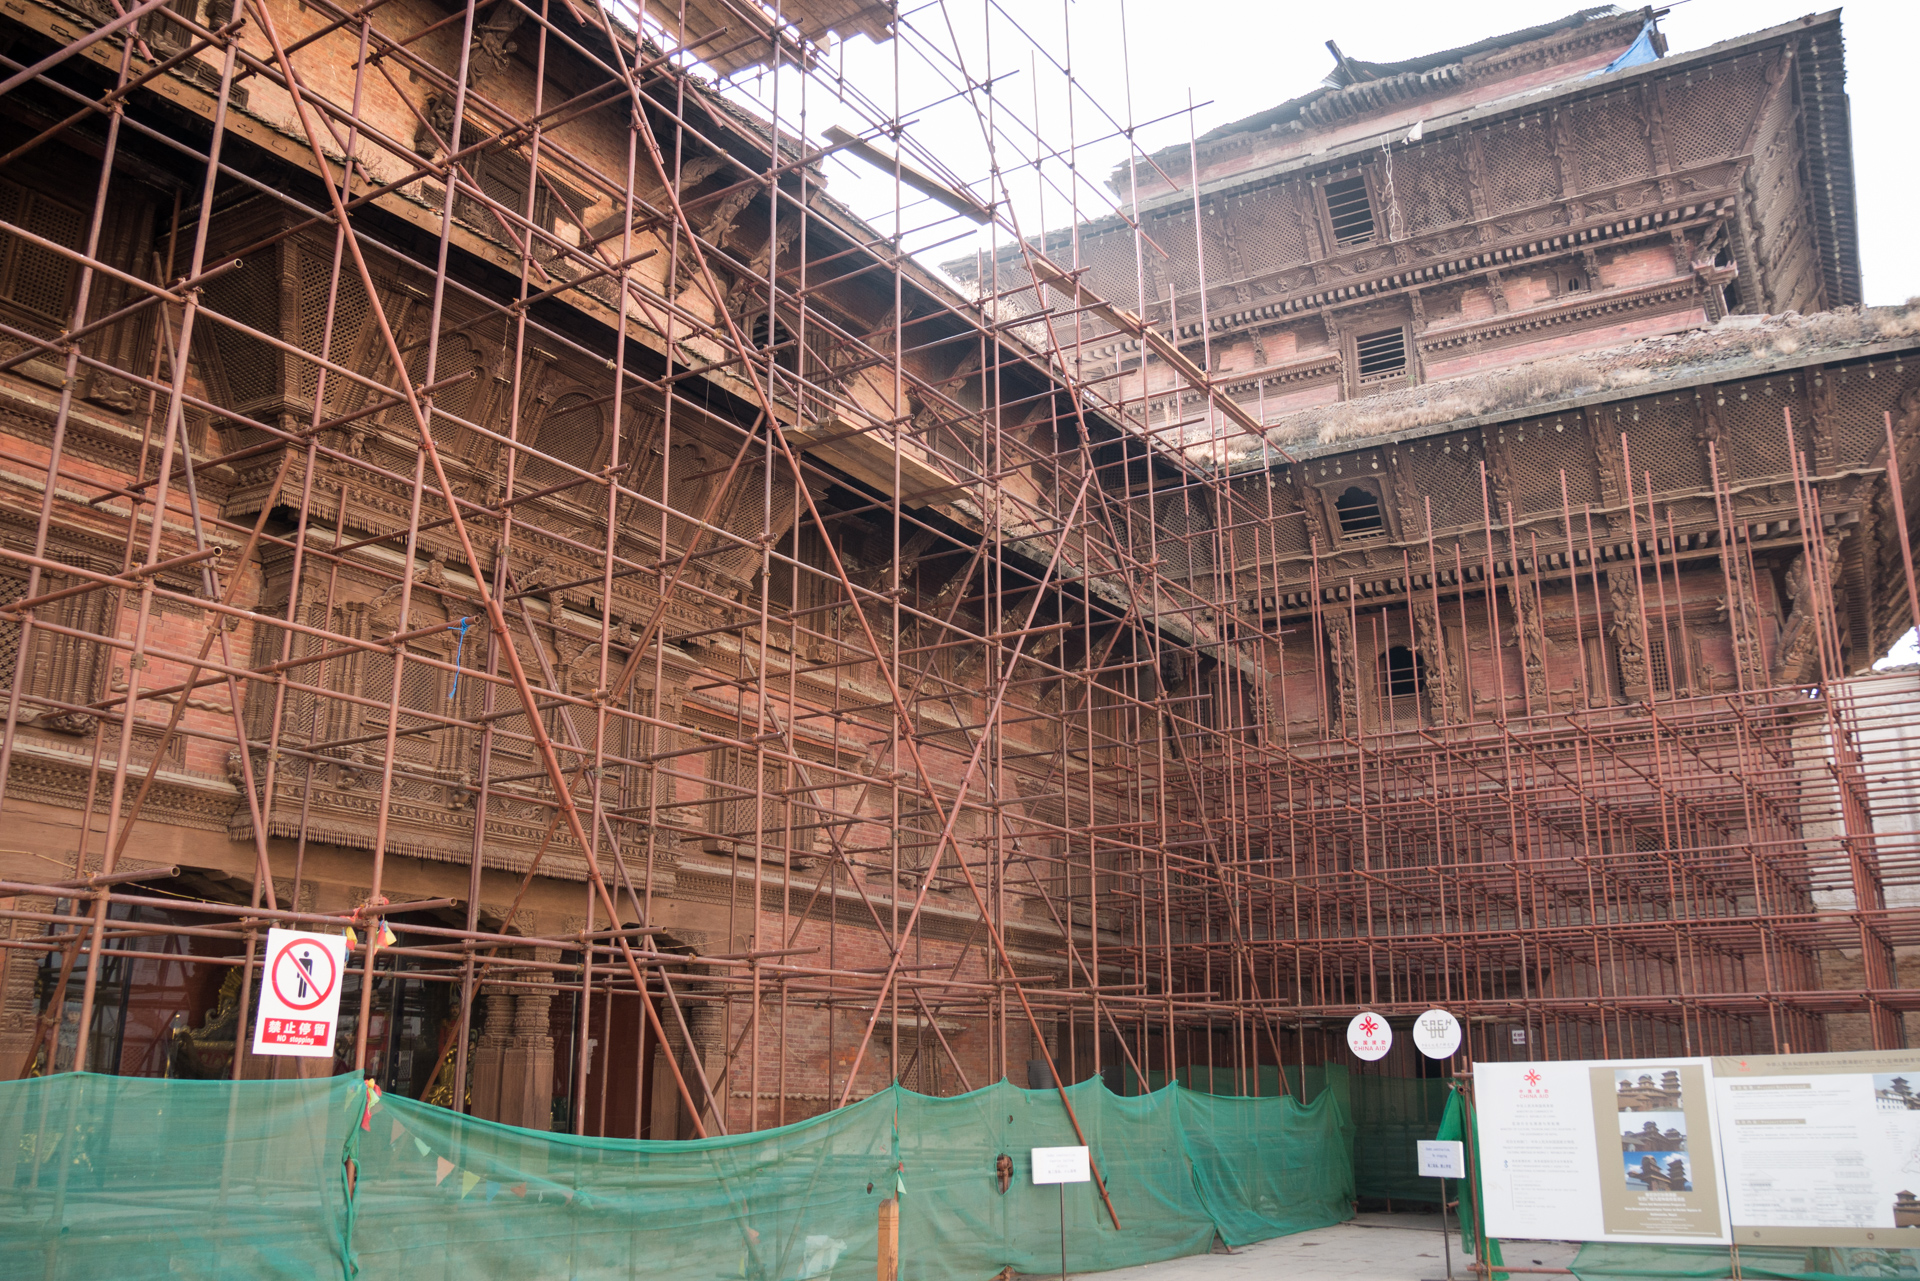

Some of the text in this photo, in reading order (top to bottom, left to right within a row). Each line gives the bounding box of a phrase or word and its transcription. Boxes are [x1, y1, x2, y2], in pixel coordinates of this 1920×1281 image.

[268, 1020, 326, 1036] 禁止停留
[289, 1036, 314, 1045] stopping
